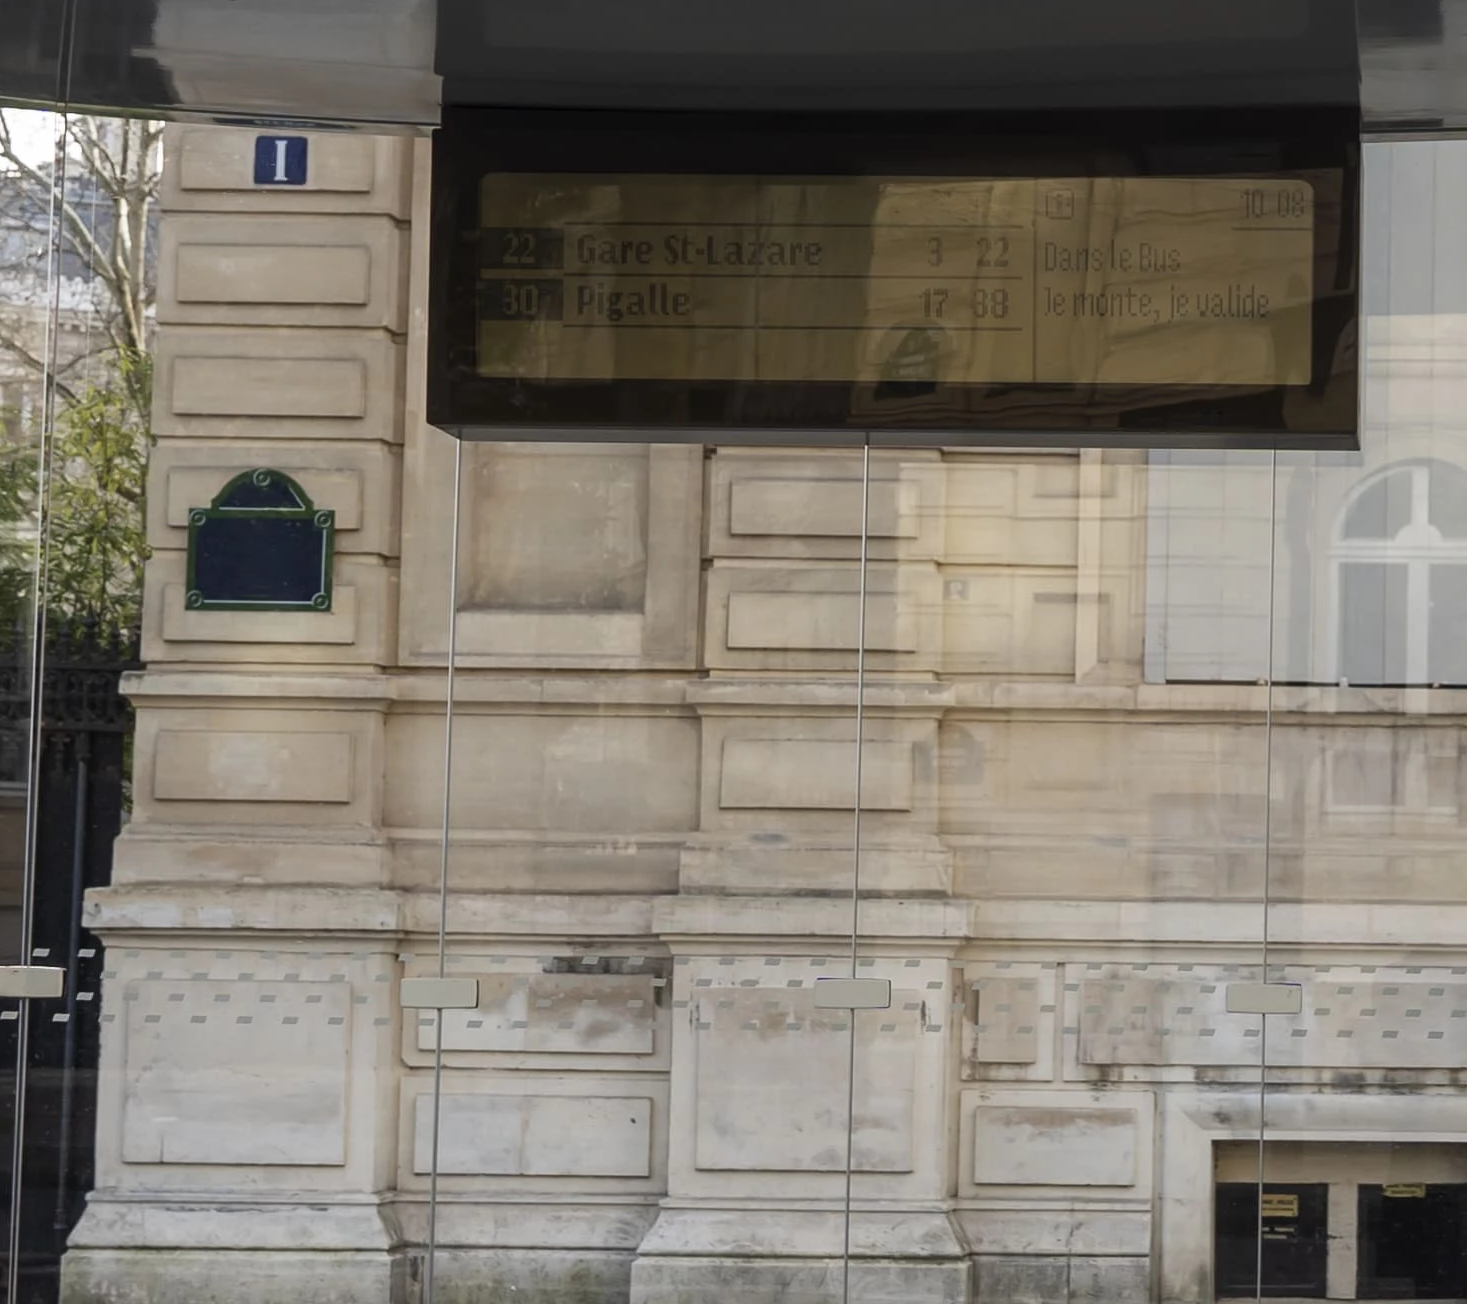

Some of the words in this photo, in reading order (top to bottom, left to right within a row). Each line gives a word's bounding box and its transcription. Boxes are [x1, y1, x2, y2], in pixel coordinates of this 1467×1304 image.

[501, 233, 537, 264] 22
[576, 234, 654, 266] Gare
[663, 233, 823, 266] St-Lazare
[927, 236, 943, 268] 3
[976, 236, 1010, 268] 22
[1044, 241, 1104, 272] Dans
[1110, 238, 1133, 272] le
[1139, 242, 1181, 273] Bus
[502, 284, 539, 316] 30
[577, 283, 690, 322] Pigalle
[918, 287, 949, 318] 17
[1073, 286, 1161, 323] monte,
[1168, 284, 1189, 324] je
[1196, 283, 1270, 318] valide
